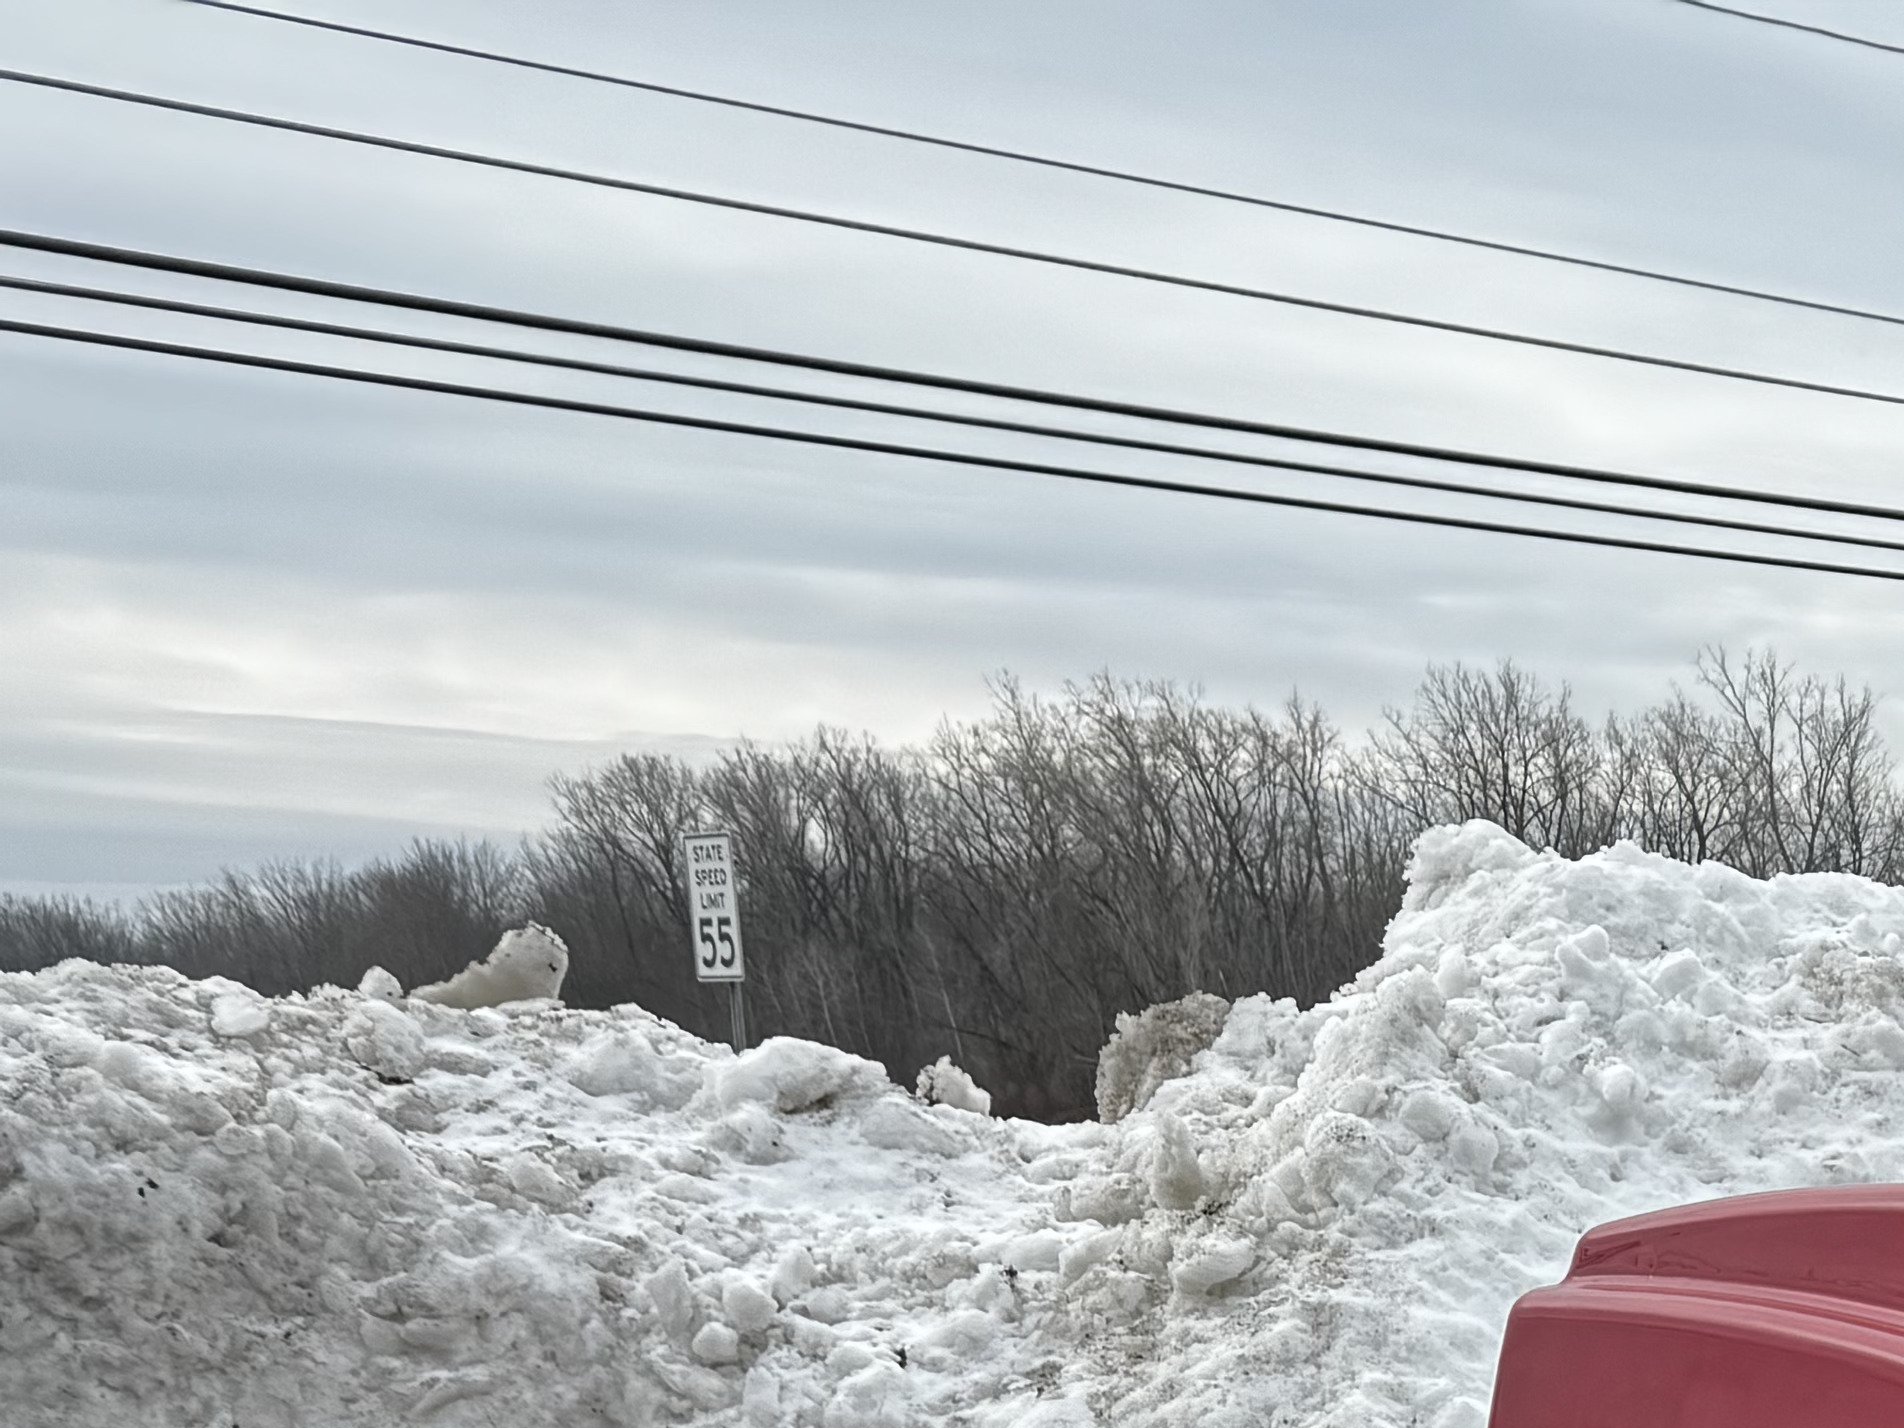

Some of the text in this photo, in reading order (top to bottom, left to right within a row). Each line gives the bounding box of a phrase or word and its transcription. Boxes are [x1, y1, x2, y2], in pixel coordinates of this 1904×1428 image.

[692, 844, 724, 863] STATE
[695, 868, 727, 887] SPEED
[700, 892, 726, 910] LIMIT
[699, 916, 736, 968] 55
